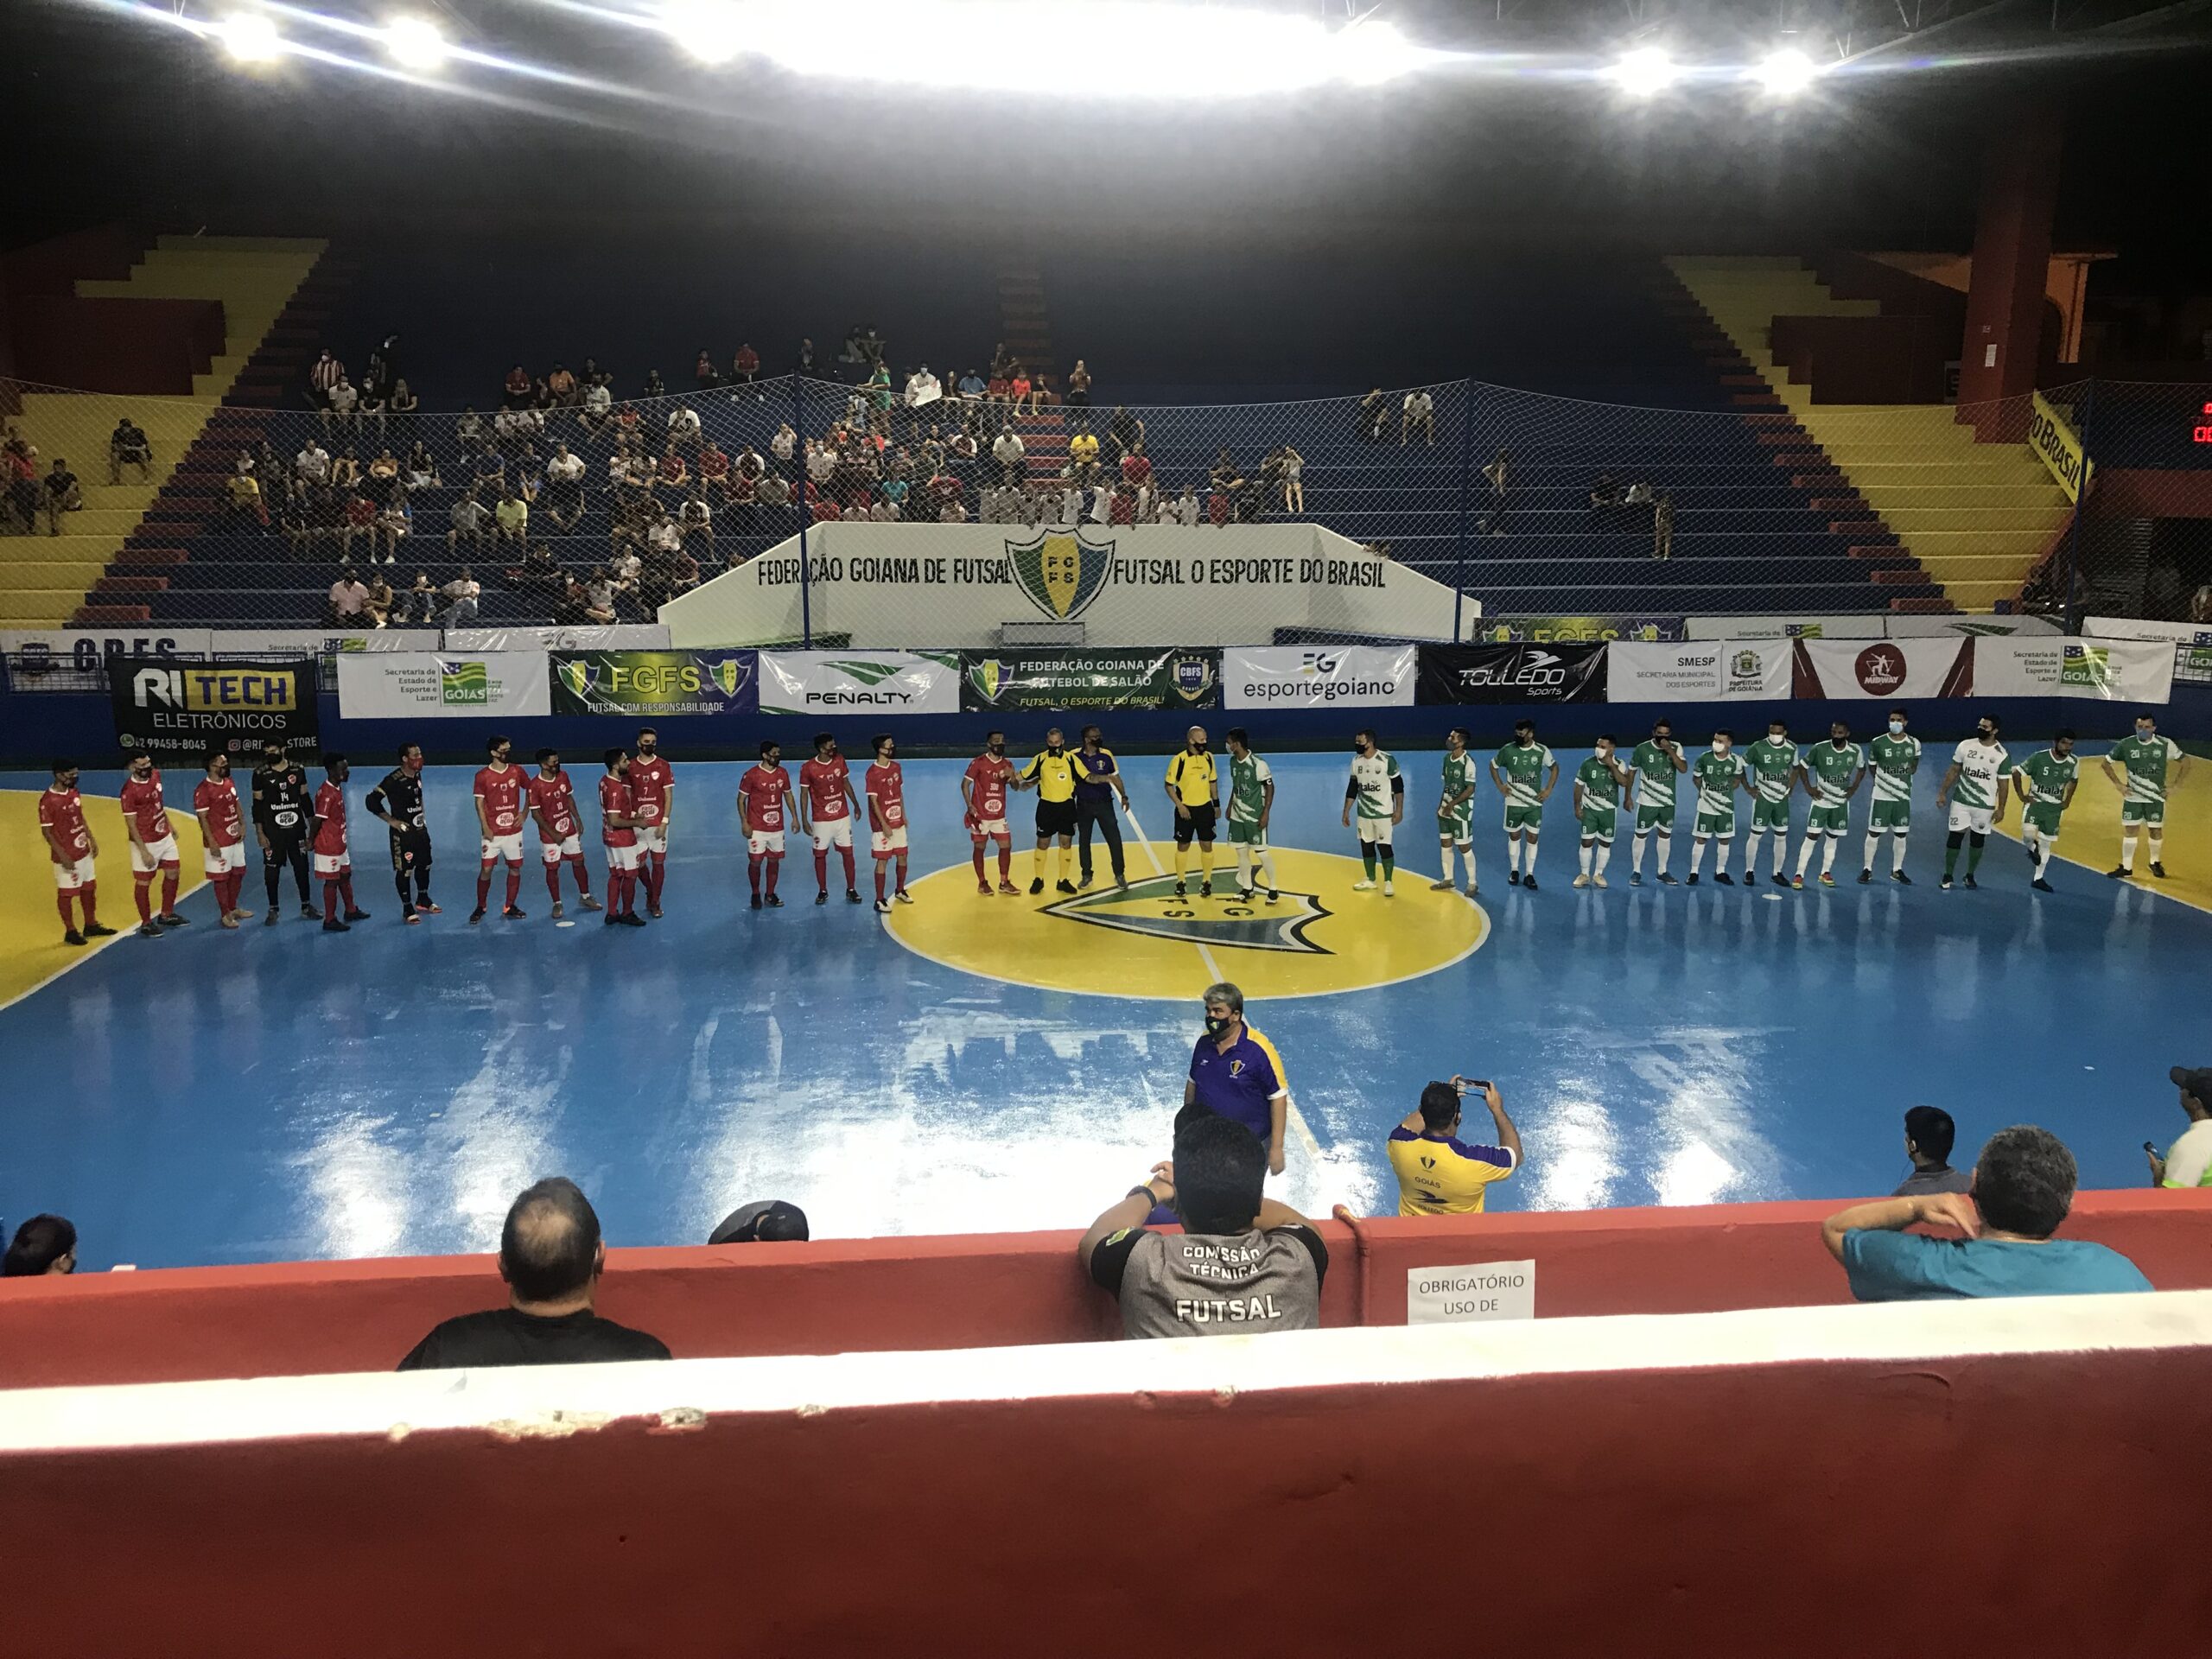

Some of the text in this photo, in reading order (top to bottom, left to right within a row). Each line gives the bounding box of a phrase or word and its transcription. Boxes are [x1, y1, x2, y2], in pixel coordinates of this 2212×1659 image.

[758, 553, 1012, 587] FEDERÇÃO GOIANA DE FUTSAL
[1113, 558, 1386, 588] FUTSAL O ESPORTE DO BRASIL
[1020, 658, 1165, 674] FEDERAÇÃO GOIANA DE
[1677, 657, 1716, 666] SMESP
[1180, 667, 1202, 677] CBFS
[1459, 669, 1566, 686] TOLLEDO
[611, 665, 702, 694] FGFS
[1093, 677, 1109, 688] DE
[1111, 674, 1152, 688] SALÃO
[1864, 676, 1899, 684] MIDWAY
[133, 668, 287, 709] RI TECH
[1243, 677, 1395, 702] esportegoiano
[1527, 687, 1562, 696] Sports
[806, 692, 912, 705] PENALTY
[1020, 697, 1059, 708] FUTSAL,
[1060, 697, 1069, 706] O
[1071, 696, 1112, 706] ESPORTE
[1114, 696, 1128, 706] DO
[621, 702, 640, 712] COM
[642, 702, 725, 712] RESPONSABILIDADE
[154, 711, 287, 729] ELETRÔNICOS
[1649, 753, 1654, 763] 9
[1764, 754, 1771, 764] 12
[1967, 749, 1978, 760] 22
[1512, 756, 1518, 766] 7
[1826, 756, 1833, 766] 13
[1591, 769, 1597, 779] 8
[1707, 765, 1713, 774] 10
[1964, 766, 1991, 780] Italac
[2043, 766, 2049, 776] 5
[1511, 774, 1537, 784] Italac
[1756, 817, 1763, 826] 12
[1810, 818, 1818, 827] 13
[1949, 817, 1959, 826] 22
[1189, 1262, 1259, 1280] TÉCNICA
[1419, 1274, 1524, 1294] OBRIGATÓRIO
[1176, 1294, 1282, 1323] FUTSAL
[1444, 1299, 1499, 1315] USO DE
